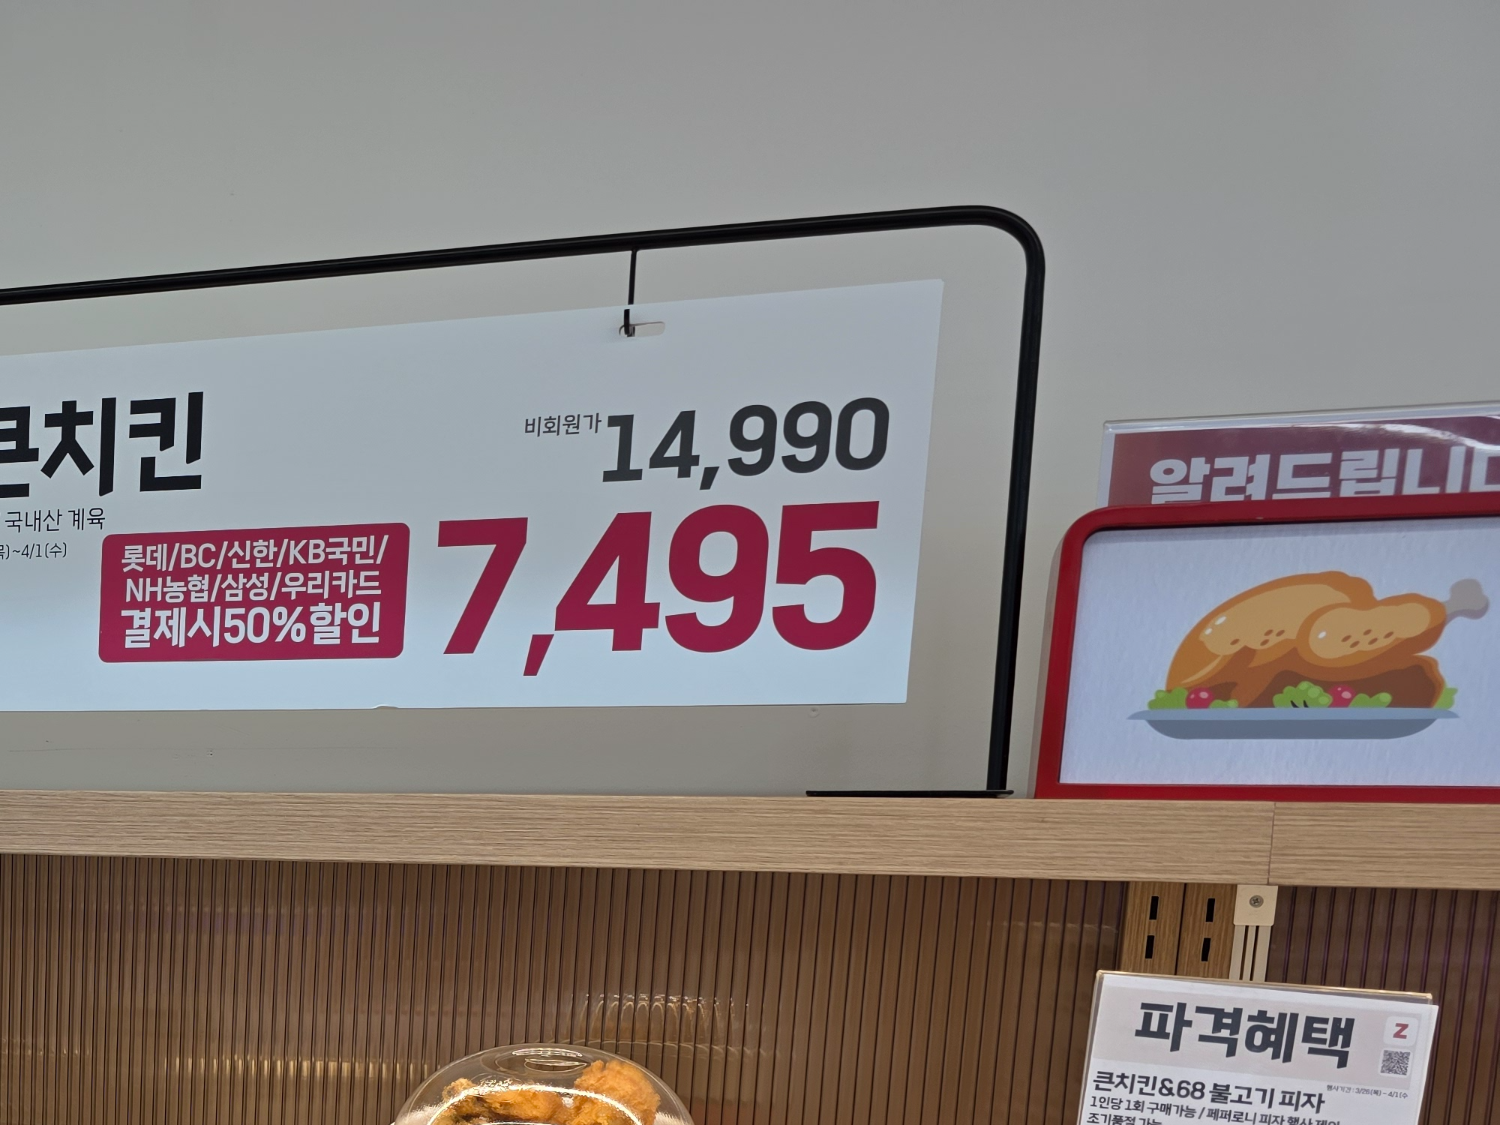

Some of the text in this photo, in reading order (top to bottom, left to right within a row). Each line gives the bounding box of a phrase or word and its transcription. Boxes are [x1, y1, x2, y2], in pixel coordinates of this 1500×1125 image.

[523, 397, 890, 490] 비회원가 14,990
[4, 508, 63, 533] 국내산
[67, 507, 106, 531] 계육
[121, 534, 390, 573] 롯데/BC/신한/KB국민/
[125, 569, 383, 604] NH농협/삼성/우리카드
[438, 500, 880, 677] 7,495
[1135, 1001, 1356, 1069] 파격혜택
[1393, 1023, 1409, 1040] Z
[1090, 1096, 1122, 1111] 1인당
[1125, 1099, 1144, 1114] 1회
[1146, 1102, 1197, 1119] 구매가능
[1206, 1108, 1256, 1125] 페퍼로니
[1092, 1070, 1325, 1114] 큰치킨&68 불고기 피자
